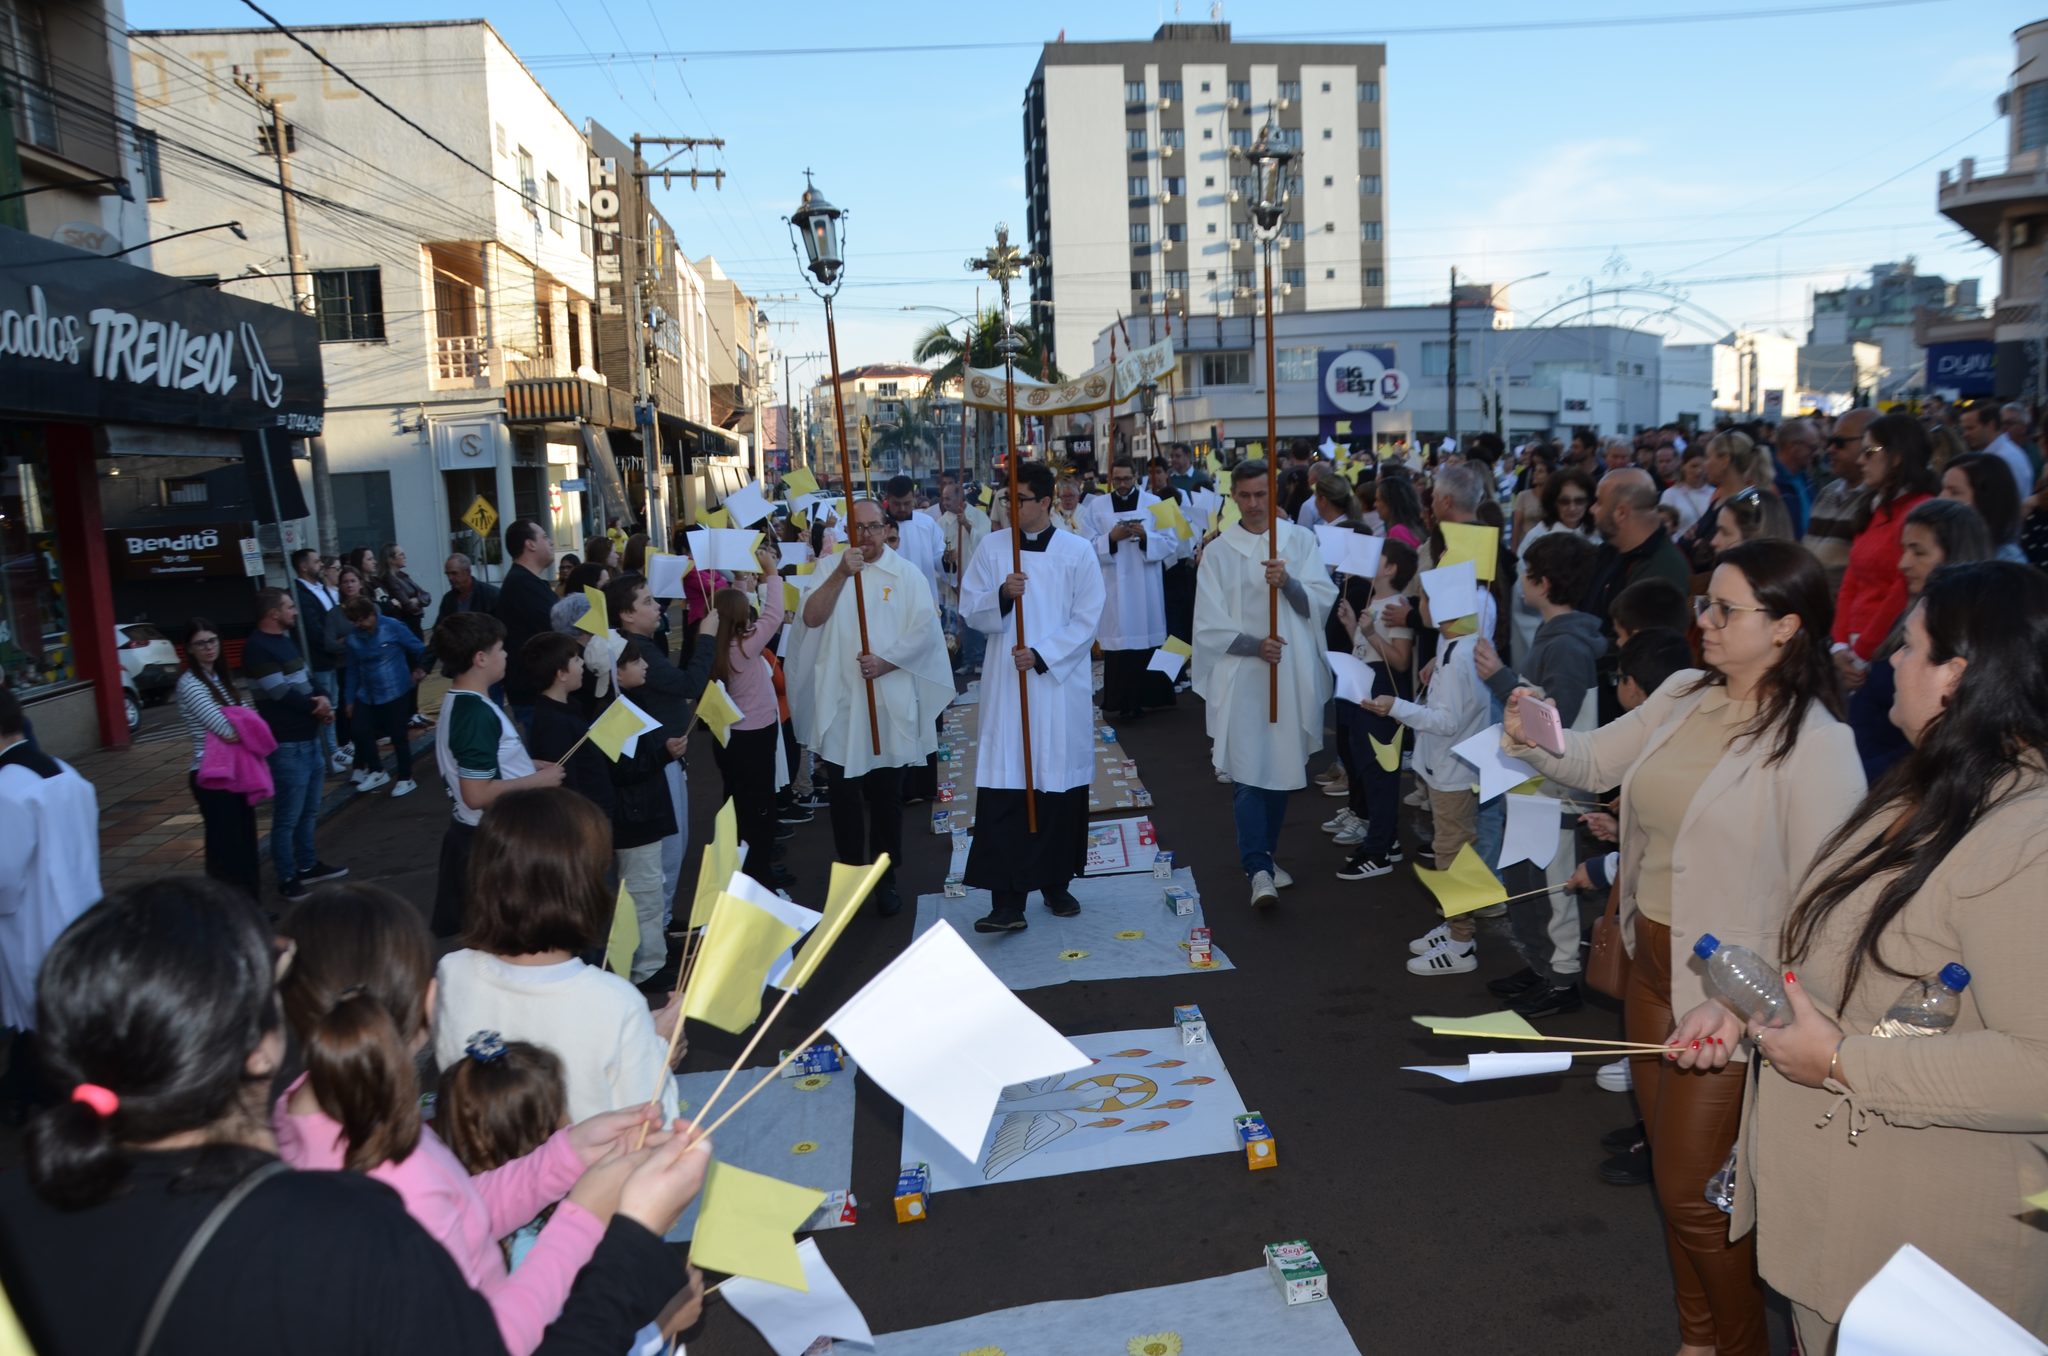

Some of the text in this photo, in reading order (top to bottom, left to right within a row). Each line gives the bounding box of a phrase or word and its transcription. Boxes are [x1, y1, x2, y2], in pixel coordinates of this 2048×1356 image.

[589, 157, 623, 314] HOTEL
[0, 284, 237, 395] ados TREVISOL
[1335, 366, 1362, 379] BIG
[1335, 379, 1376, 394] BEST
